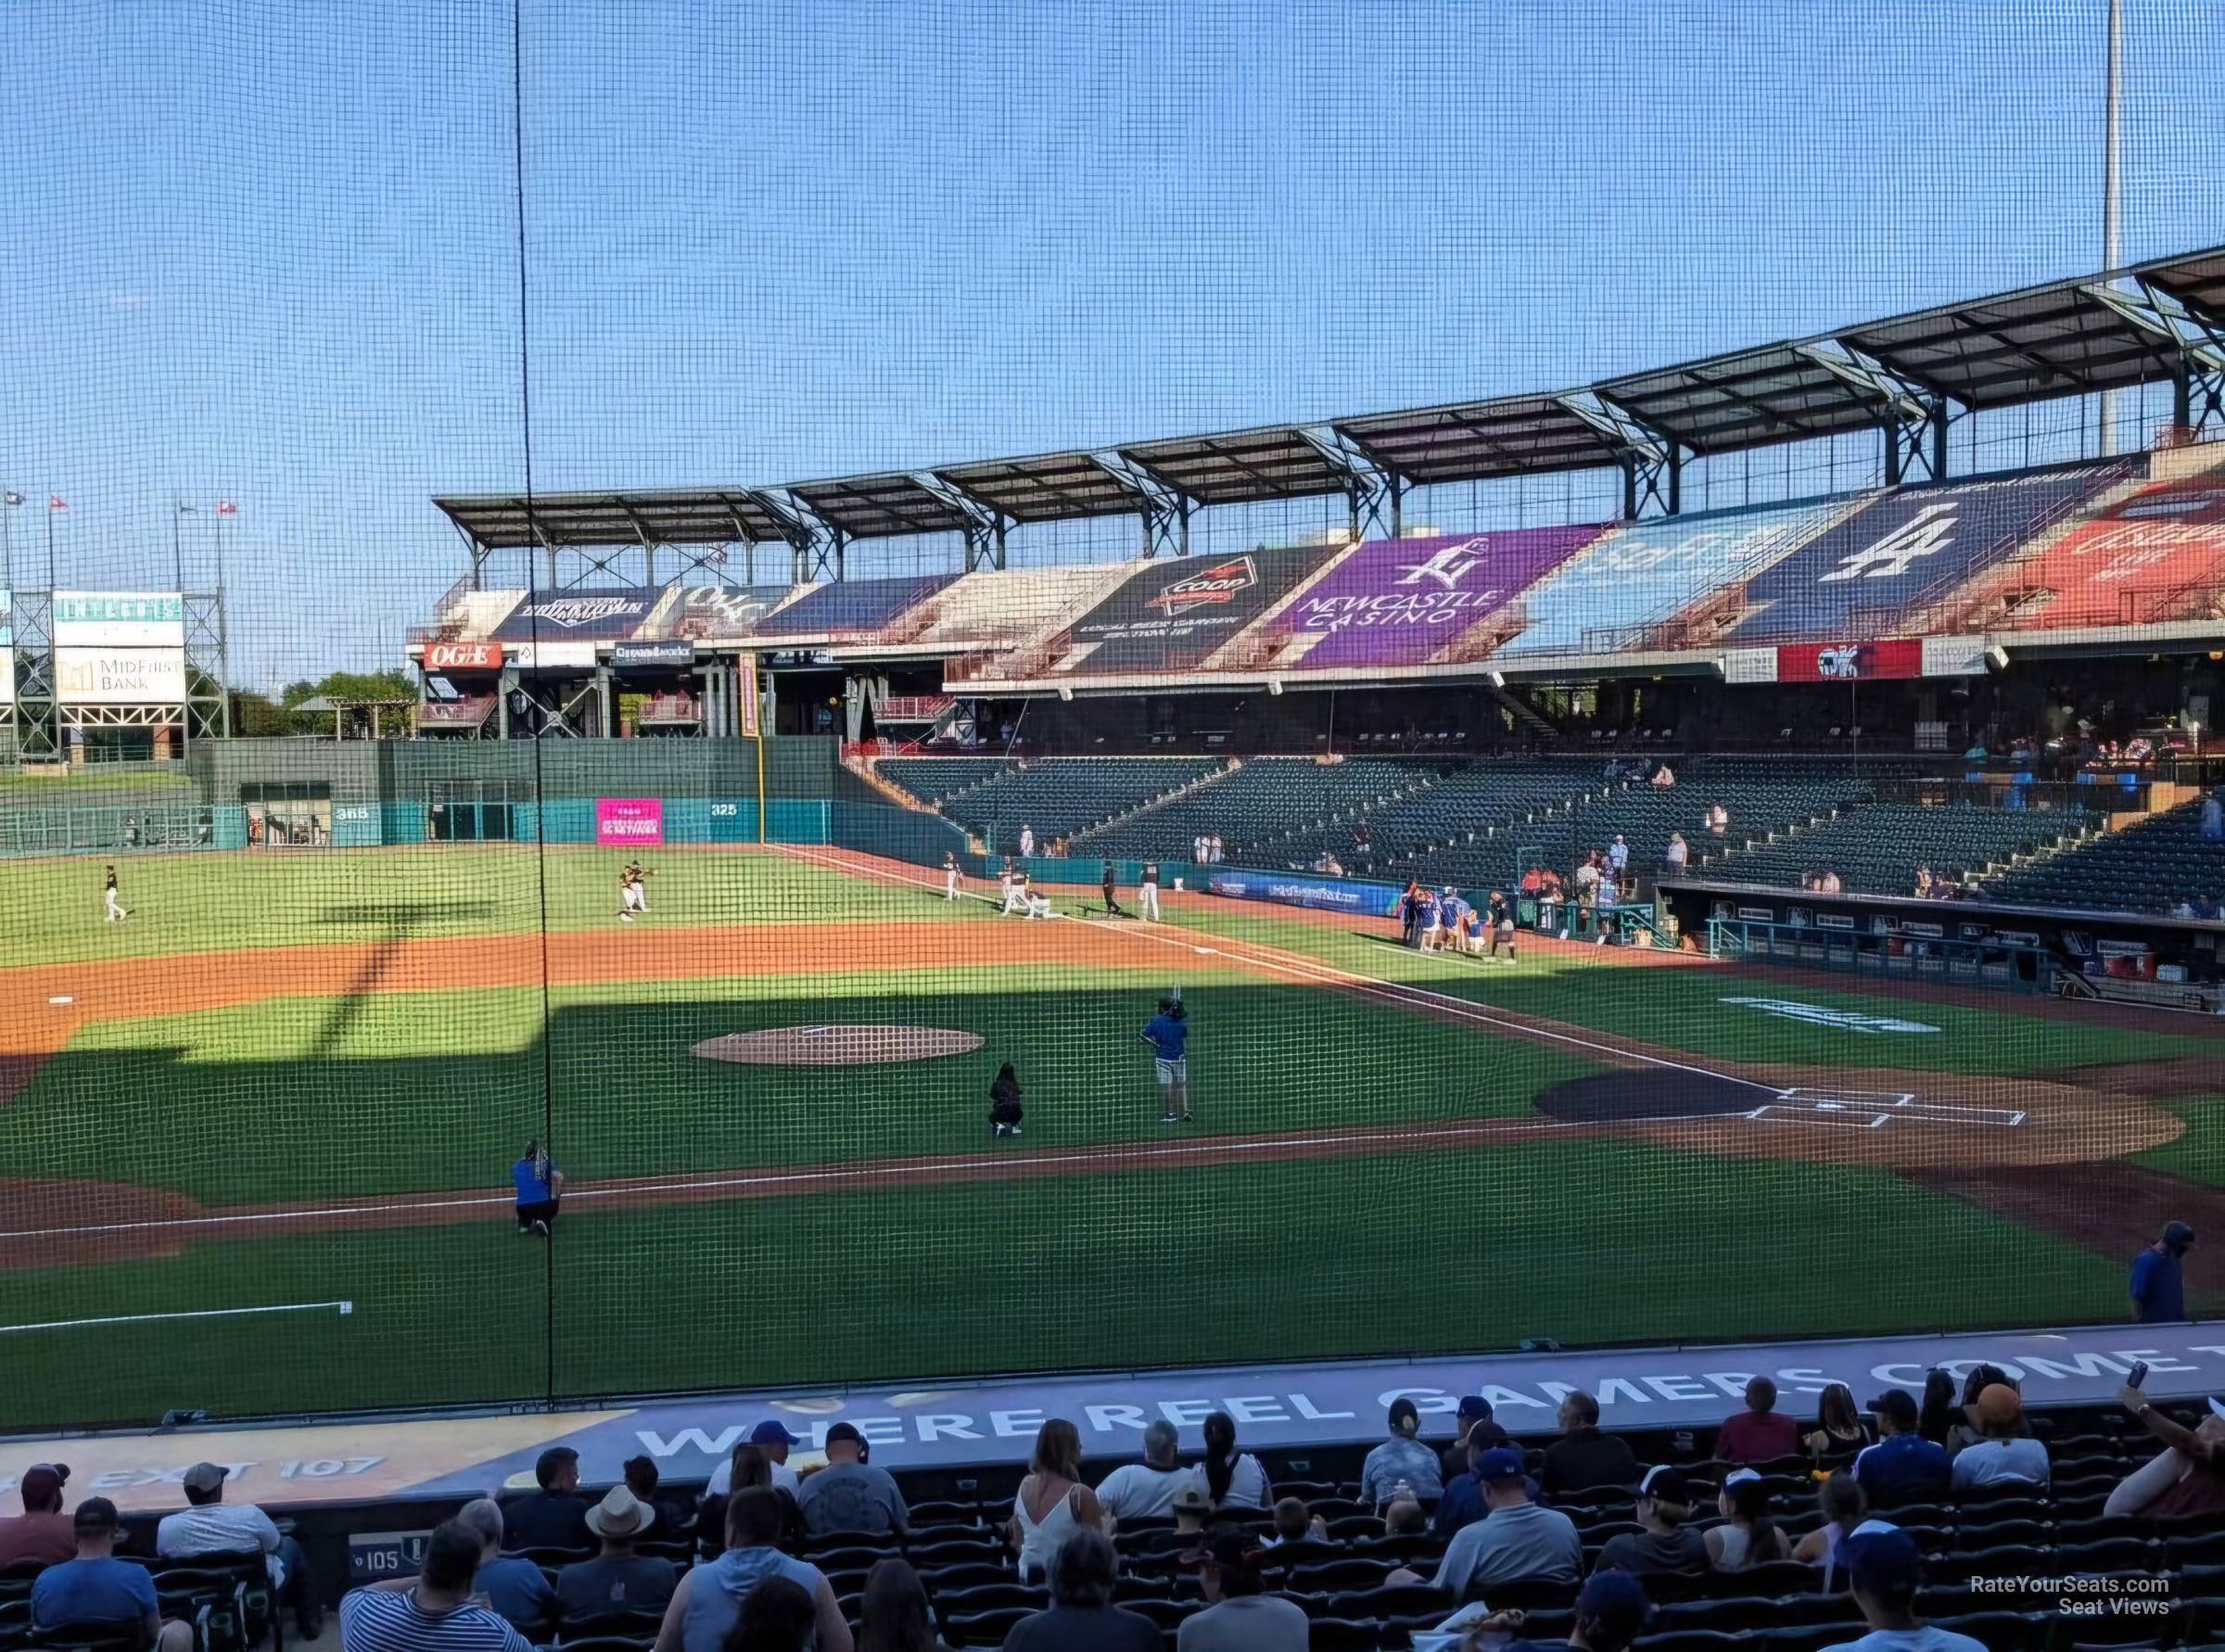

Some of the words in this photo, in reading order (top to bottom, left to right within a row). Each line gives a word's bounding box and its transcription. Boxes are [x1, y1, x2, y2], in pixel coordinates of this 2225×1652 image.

[1298, 590, 1506, 613] NEWCASTLE
[1304, 608, 1456, 627] CASINO
[711, 804, 738, 817] 325
[1084, 1393, 1356, 1431] REEL
[1377, 1367, 1851, 1415] GAMERS
[1870, 1349, 2202, 1388] COME
[88, 1461, 261, 1488] EXT
[280, 1455, 388, 1480] 107
[367, 1550, 400, 1571] 105
